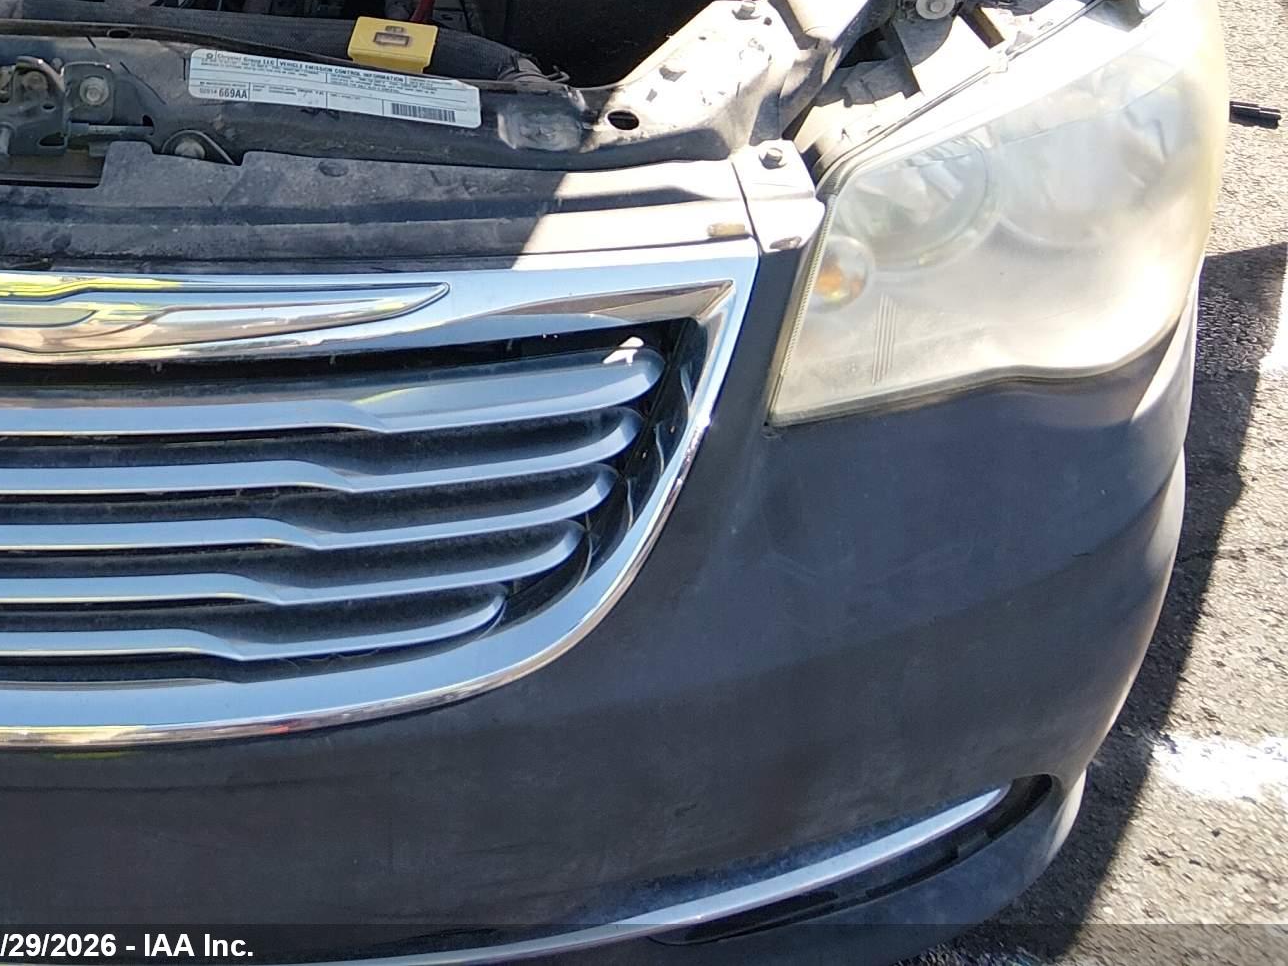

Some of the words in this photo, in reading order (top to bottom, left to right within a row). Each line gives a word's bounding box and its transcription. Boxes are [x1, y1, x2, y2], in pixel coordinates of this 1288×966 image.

[279, 60, 303, 69] VEHICLE
[304, 63, 333, 73] EMISSION
[334, 67, 361, 77] CONTROL
